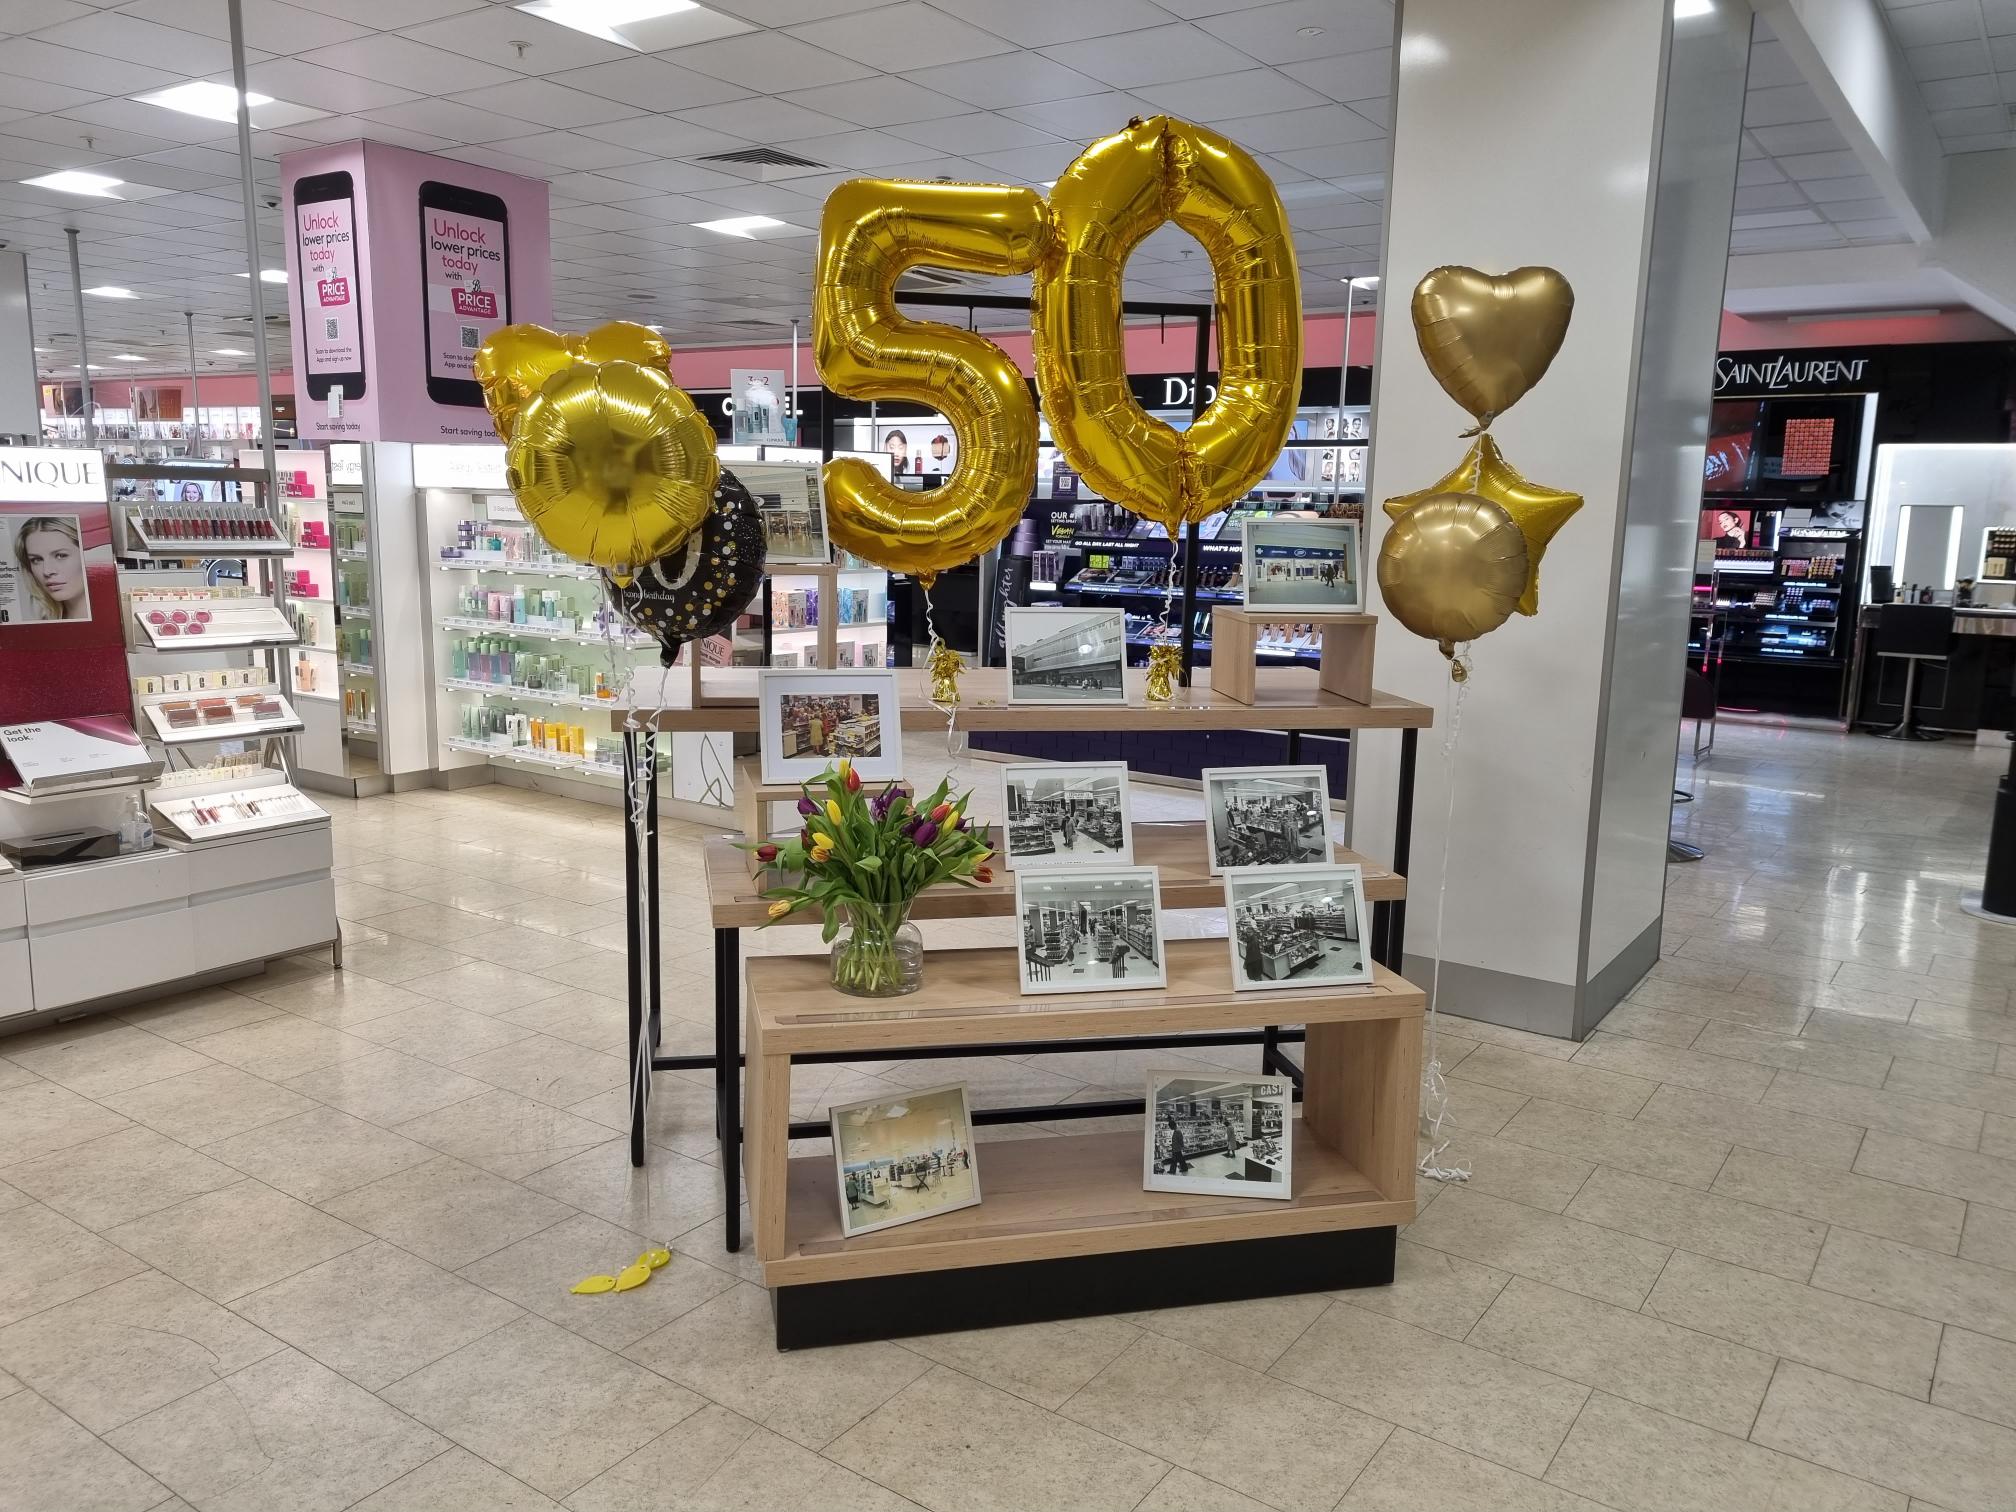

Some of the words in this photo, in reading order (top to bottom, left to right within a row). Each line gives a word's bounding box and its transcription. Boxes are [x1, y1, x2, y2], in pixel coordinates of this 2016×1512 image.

[303, 210, 340, 232] Unlock
[302, 232, 325, 247] lower
[326, 229, 350, 248] prices
[433, 217, 487, 245] Unlock
[309, 246, 335, 262] today
[430, 235, 465, 254] lower
[467, 245, 501, 262] prices
[311, 263, 325, 273] with
[441, 254, 479, 276] today
[445, 270, 463, 281] with
[322, 281, 346, 297] PRICE
[458, 292, 492, 309] PRICE
[458, 305, 492, 315] ADVANTAGE
[443, 352, 457, 360] Scan
[456, 361, 468, 369] and
[316, 422, 329, 431] Start
[329, 421, 346, 433] saving
[346, 421, 361, 432] today
[440, 425, 459, 435] Start
[460, 427, 483, 439] saving
[1, 460, 100, 488] NIQUE
[1050, 511, 1068, 519] OUR
[642, 588, 675, 603] birthday
[700, 637, 725, 657] NIQUE
[3, 728, 23, 736] Get
[7, 735, 34, 743] look.
